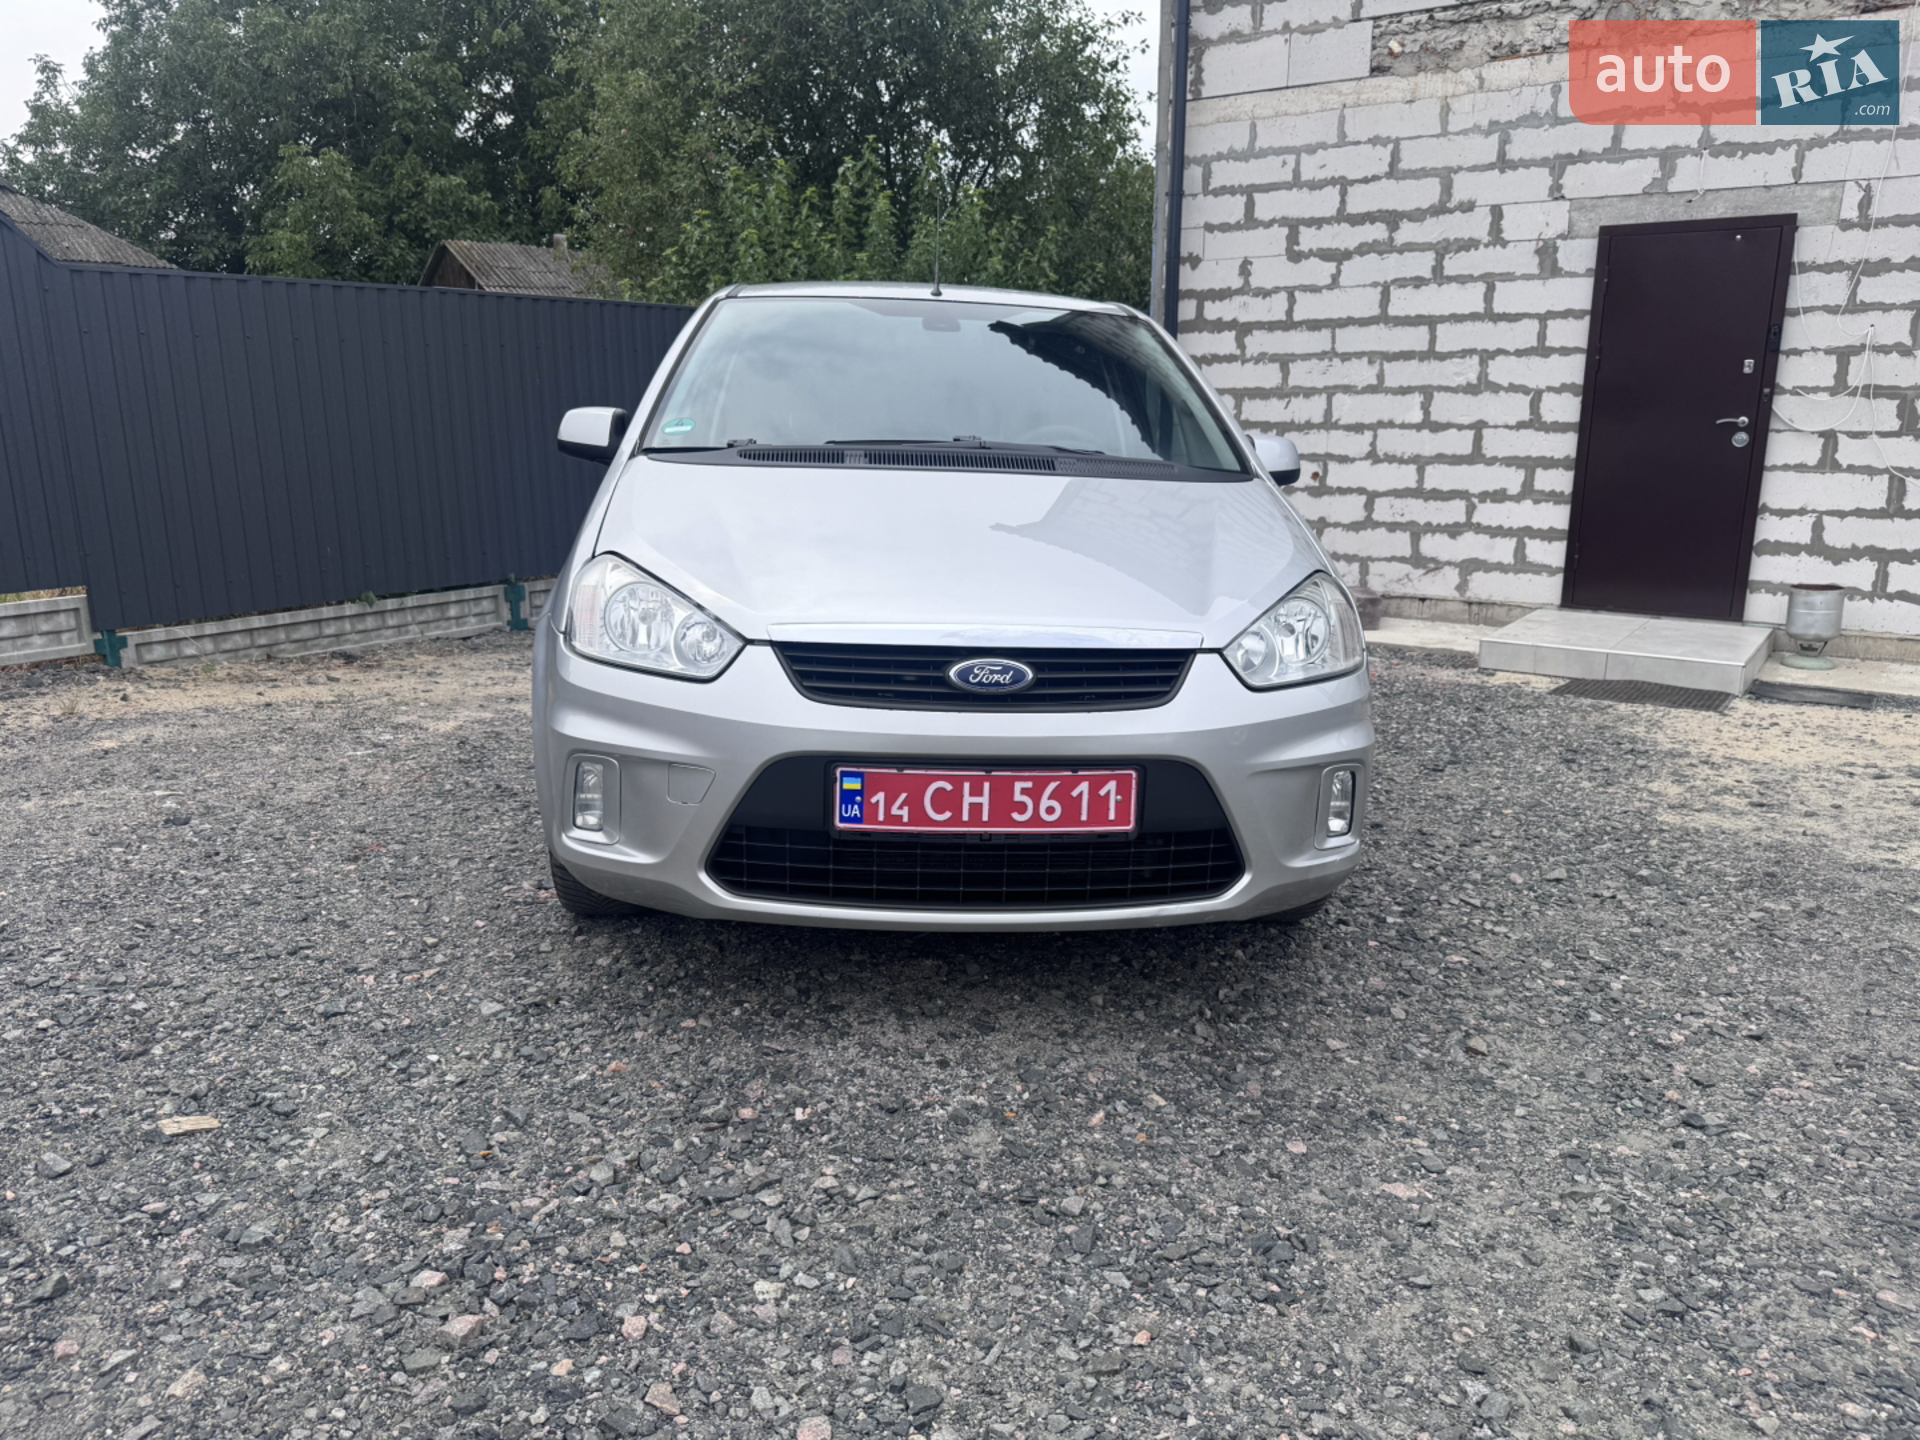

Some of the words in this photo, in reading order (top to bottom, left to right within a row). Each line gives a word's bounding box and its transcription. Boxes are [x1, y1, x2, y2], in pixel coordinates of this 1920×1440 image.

[968, 664, 1014, 684] Ford
[841, 804, 861, 818] UA
[869, 791, 909, 823] 14
[923, 780, 990, 822] CH
[1010, 780, 1117, 823] 5611
